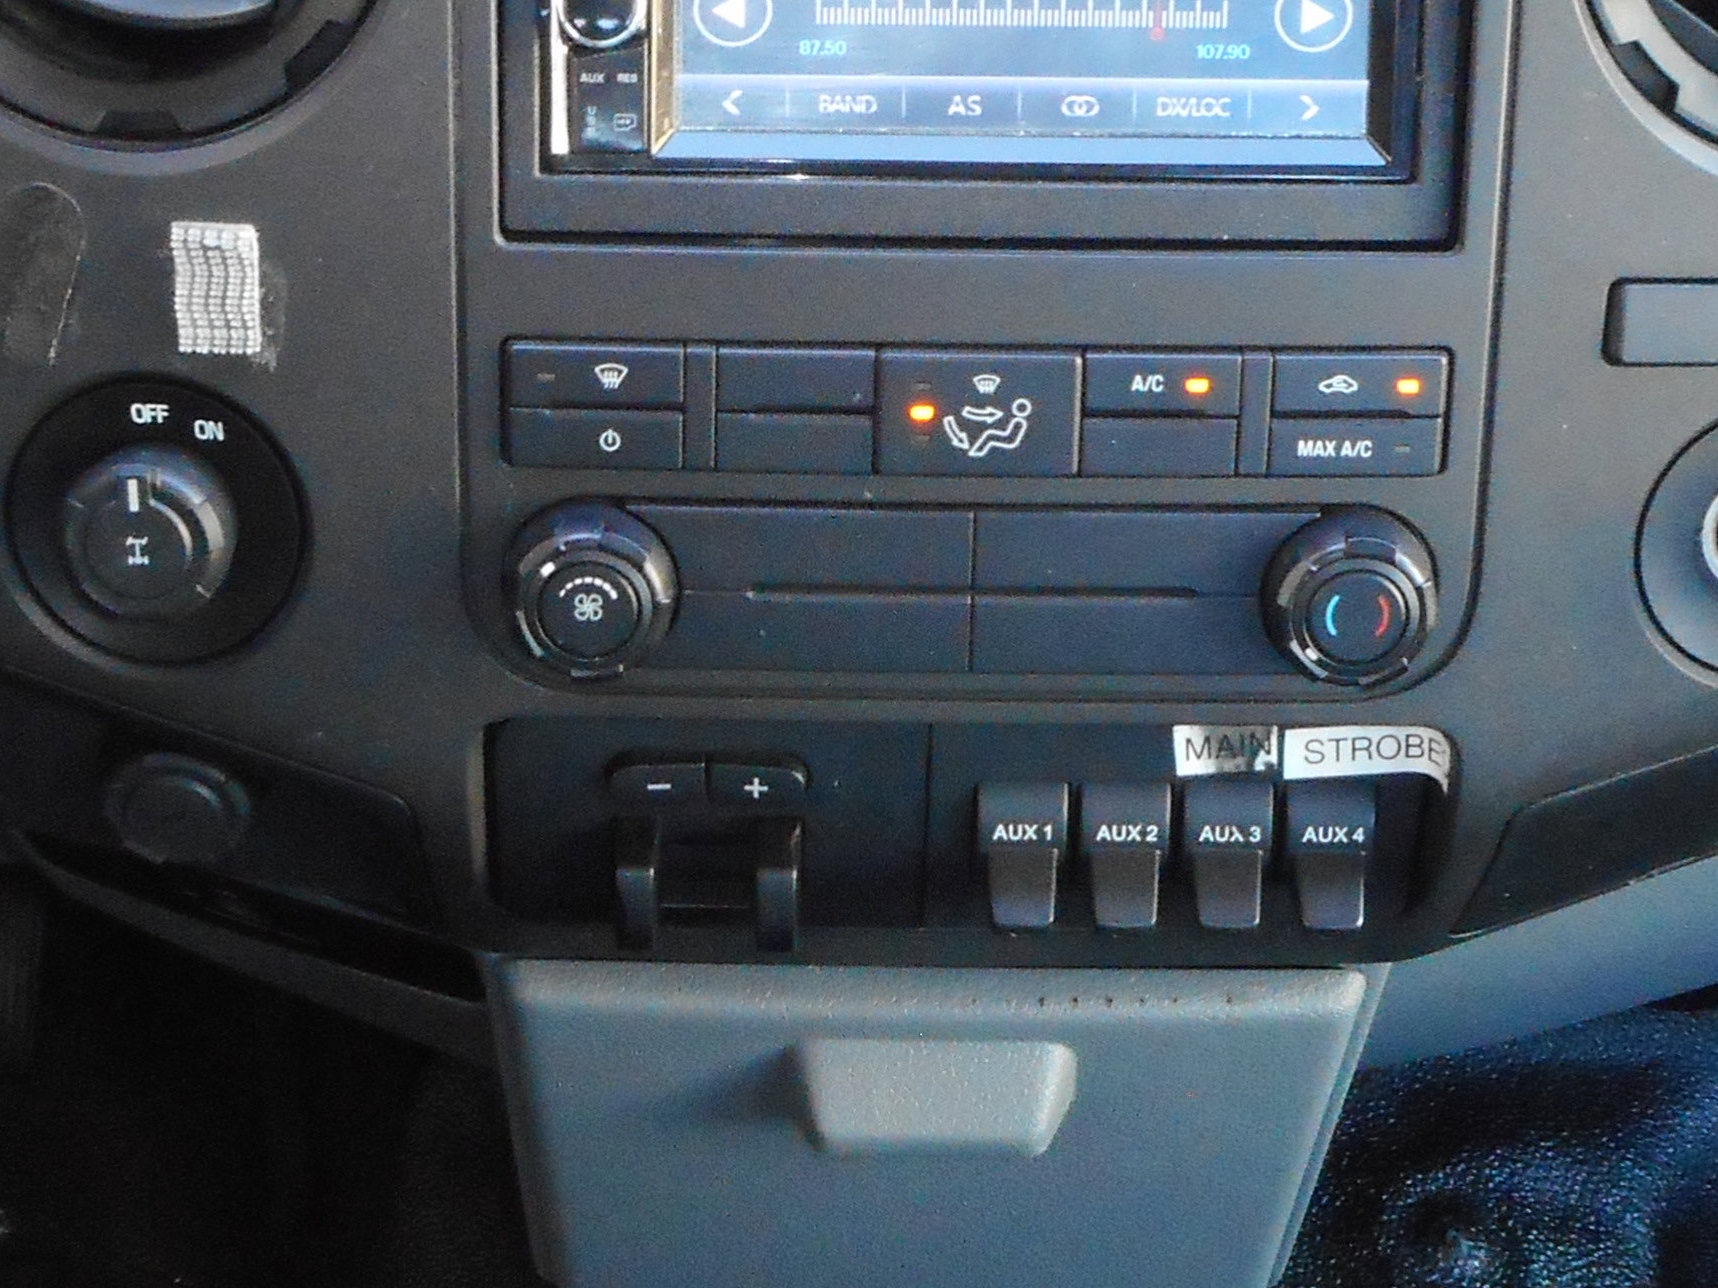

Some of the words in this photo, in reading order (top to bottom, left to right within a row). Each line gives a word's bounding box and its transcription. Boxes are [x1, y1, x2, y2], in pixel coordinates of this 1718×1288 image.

[799, 39, 847, 56] 87.50
[1196, 43, 1251, 60] 107.90
[580, 73, 605, 83] AUX
[818, 94, 878, 114] BAND
[948, 95, 982, 116] AS
[1156, 96, 1231, 117] DX/LOC
[1131, 374, 1165, 393] A/C
[130, 403, 170, 425] OFF
[194, 419, 225, 442] ON
[1297, 440, 1336, 458] MAX
[1339, 440, 1374, 458] A/C
[1185, 731, 1273, 762] MAIN
[1304, 733, 1443, 769] STROBE
[993, 824, 1039, 842] AUX
[1042, 824, 1053, 842] 1
[1096, 824, 1142, 842] AUX
[1145, 824, 1160, 842] 2
[1248, 825, 1262, 843] 3
[1301, 825, 1348, 843] AUX
[1351, 825, 1366, 844] 4
